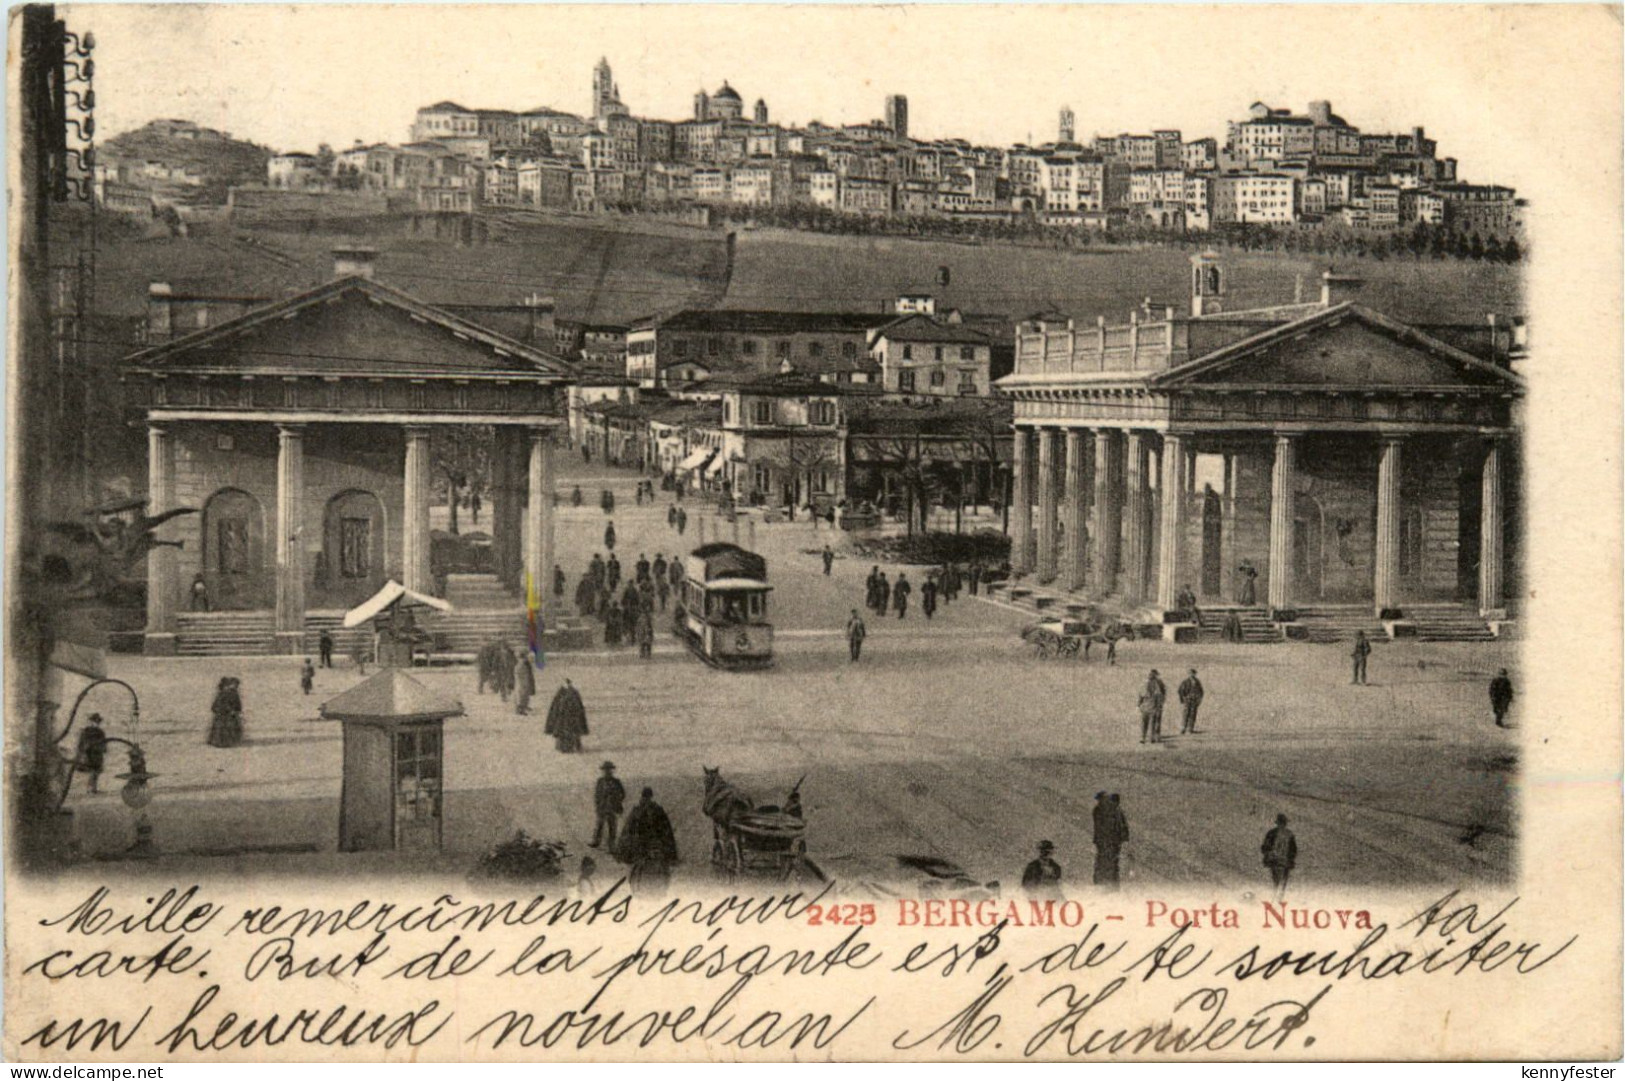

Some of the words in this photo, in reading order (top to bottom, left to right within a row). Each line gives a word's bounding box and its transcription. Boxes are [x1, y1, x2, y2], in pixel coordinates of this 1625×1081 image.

[38, 884, 225, 936] Mille
[637, 880, 837, 950] pour
[1400, 889, 1521, 937] ta
[806, 903, 877, 927] 2425
[897, 899, 1085, 928] BERGAMO
[1145, 899, 1240, 928] Porta
[1262, 900, 1373, 930] Nuova
[22, 934, 211, 984] carte.
[244, 932, 391, 982] But
[381, 934, 496, 980] de
[495, 934, 603, 977] la
[1019, 922, 1128, 974] de
[1122, 920, 1213, 983] te
[1214, 922, 1580, 981] souhaiter
[20, 1004, 153, 1053] un
[154, 983, 456, 1054] heureux
[464, 973, 754, 1051] nouvel
[891, 974, 1015, 1054] M.
